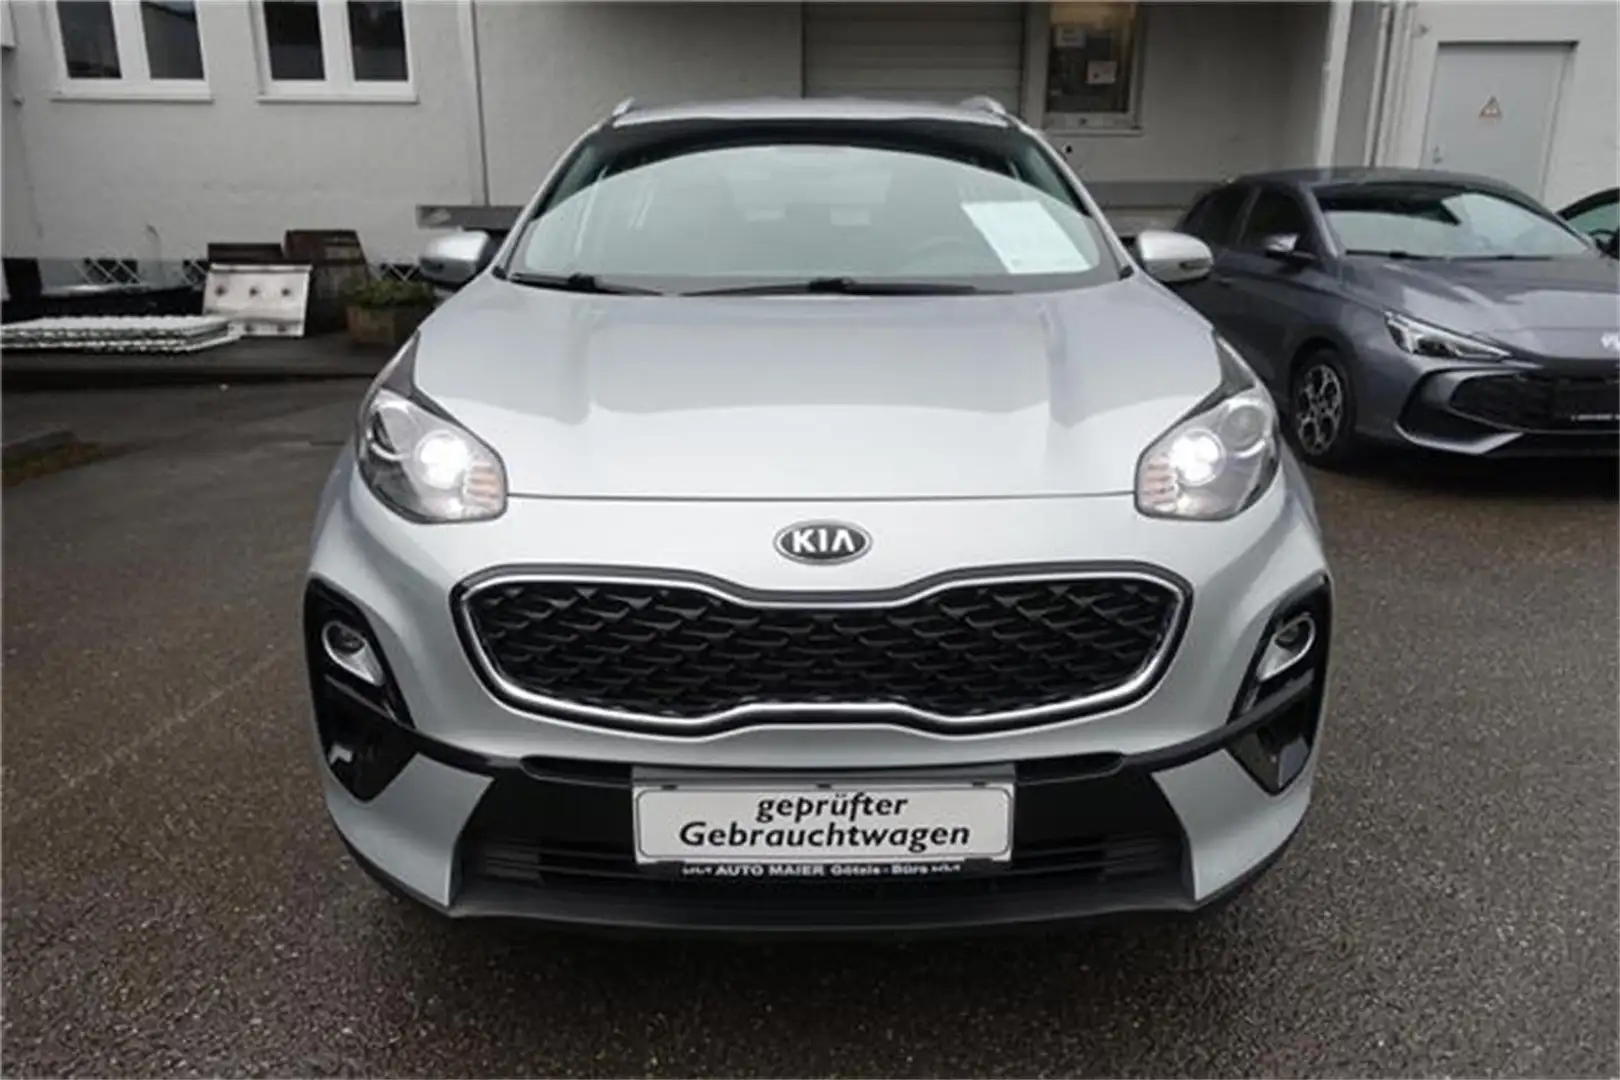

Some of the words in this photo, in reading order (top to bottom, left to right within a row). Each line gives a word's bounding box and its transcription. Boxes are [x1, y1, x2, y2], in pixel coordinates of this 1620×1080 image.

[793, 528, 855, 552] KIA
[756, 792, 909, 823] geprüfter
[679, 821, 971, 853] Gebrauchtwagen
[715, 864, 764, 876] AUTO
[768, 864, 825, 876] MAIER
